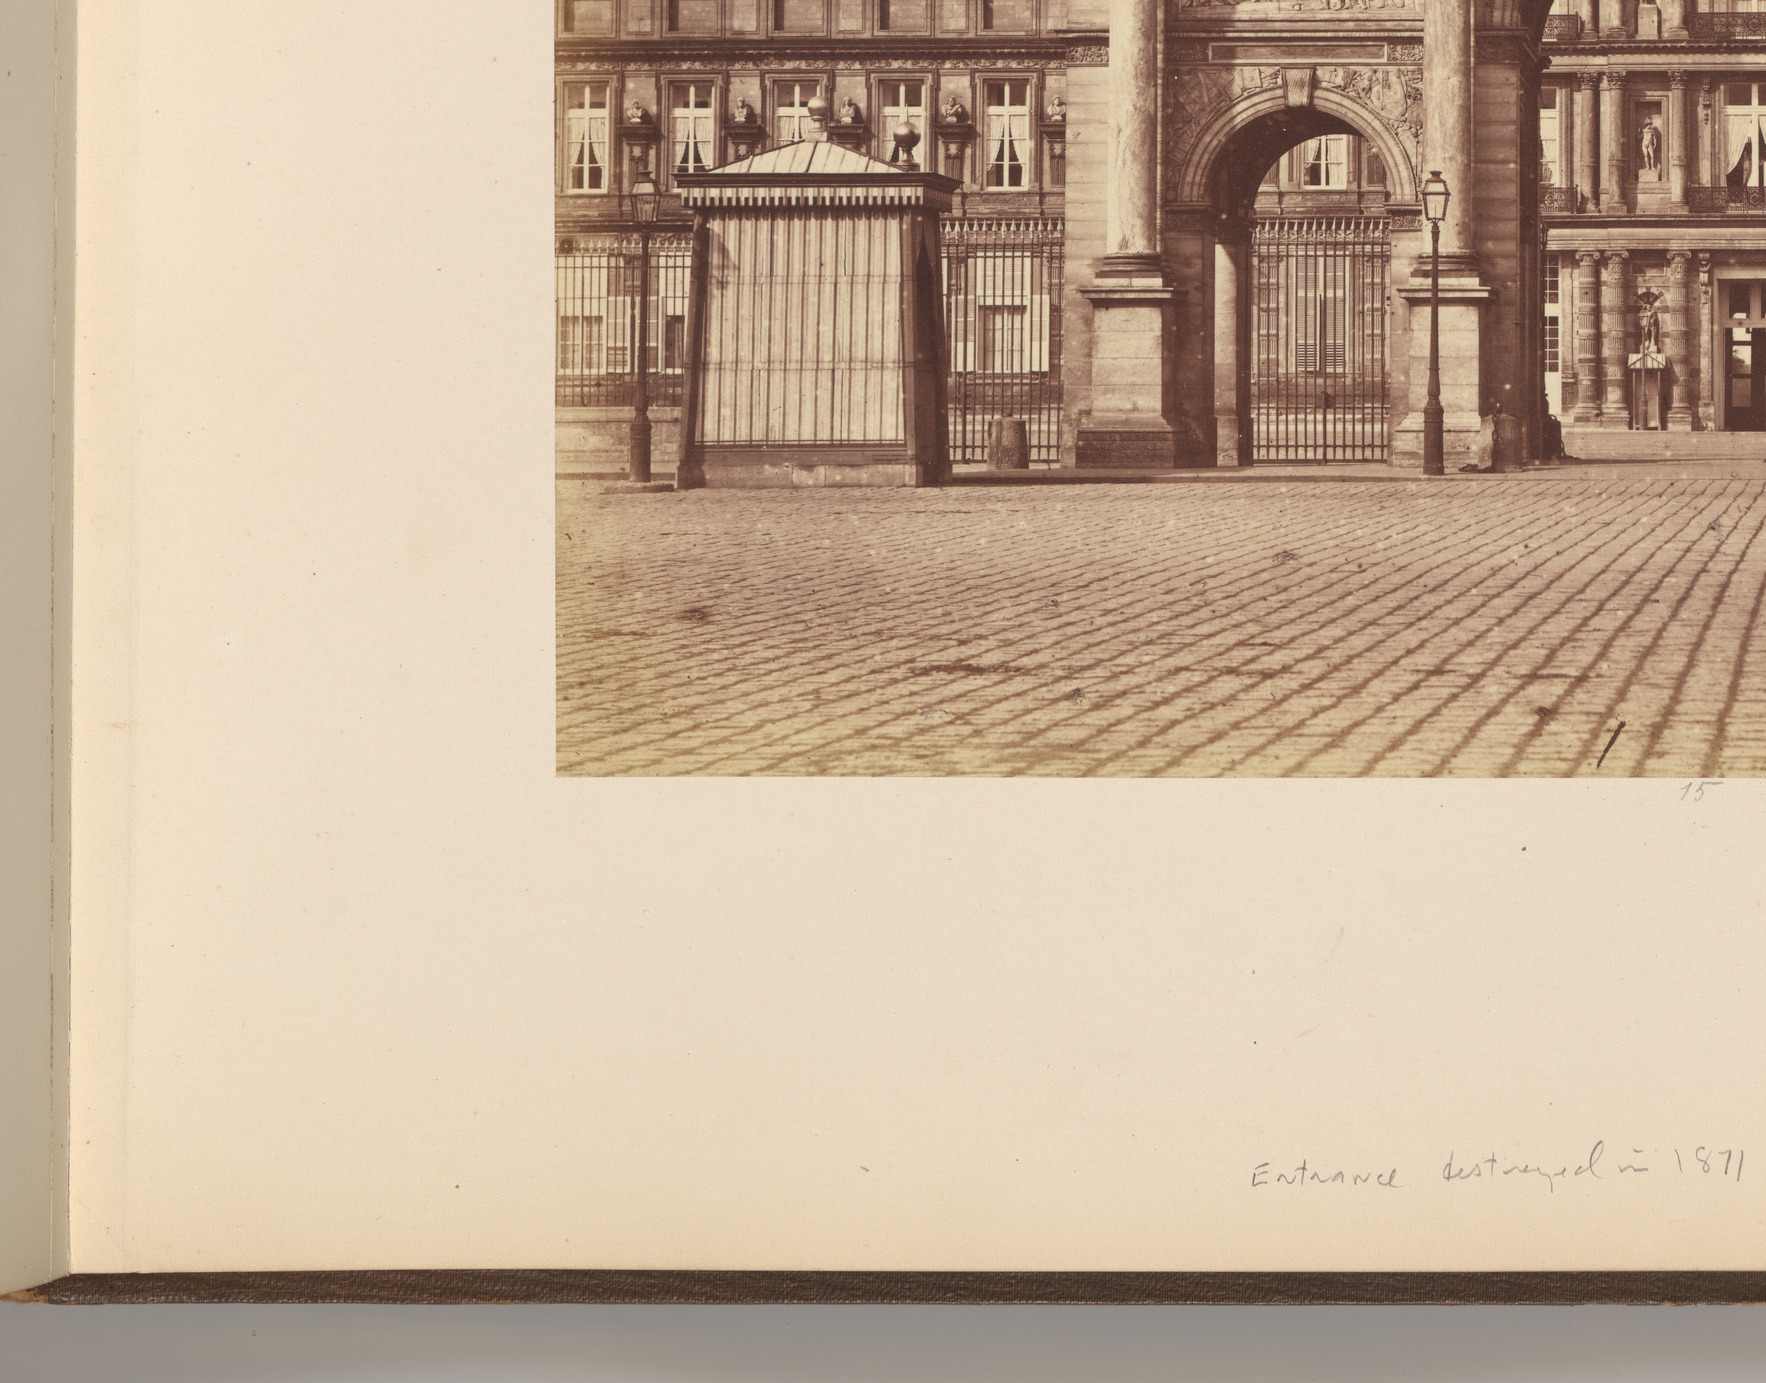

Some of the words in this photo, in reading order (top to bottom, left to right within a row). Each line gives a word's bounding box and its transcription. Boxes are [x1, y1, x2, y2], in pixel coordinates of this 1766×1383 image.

[1680, 781, 1724, 802] 15
[1251, 1159, 1405, 1188] Entrance
[1674, 1146, 1745, 1182] 1871
